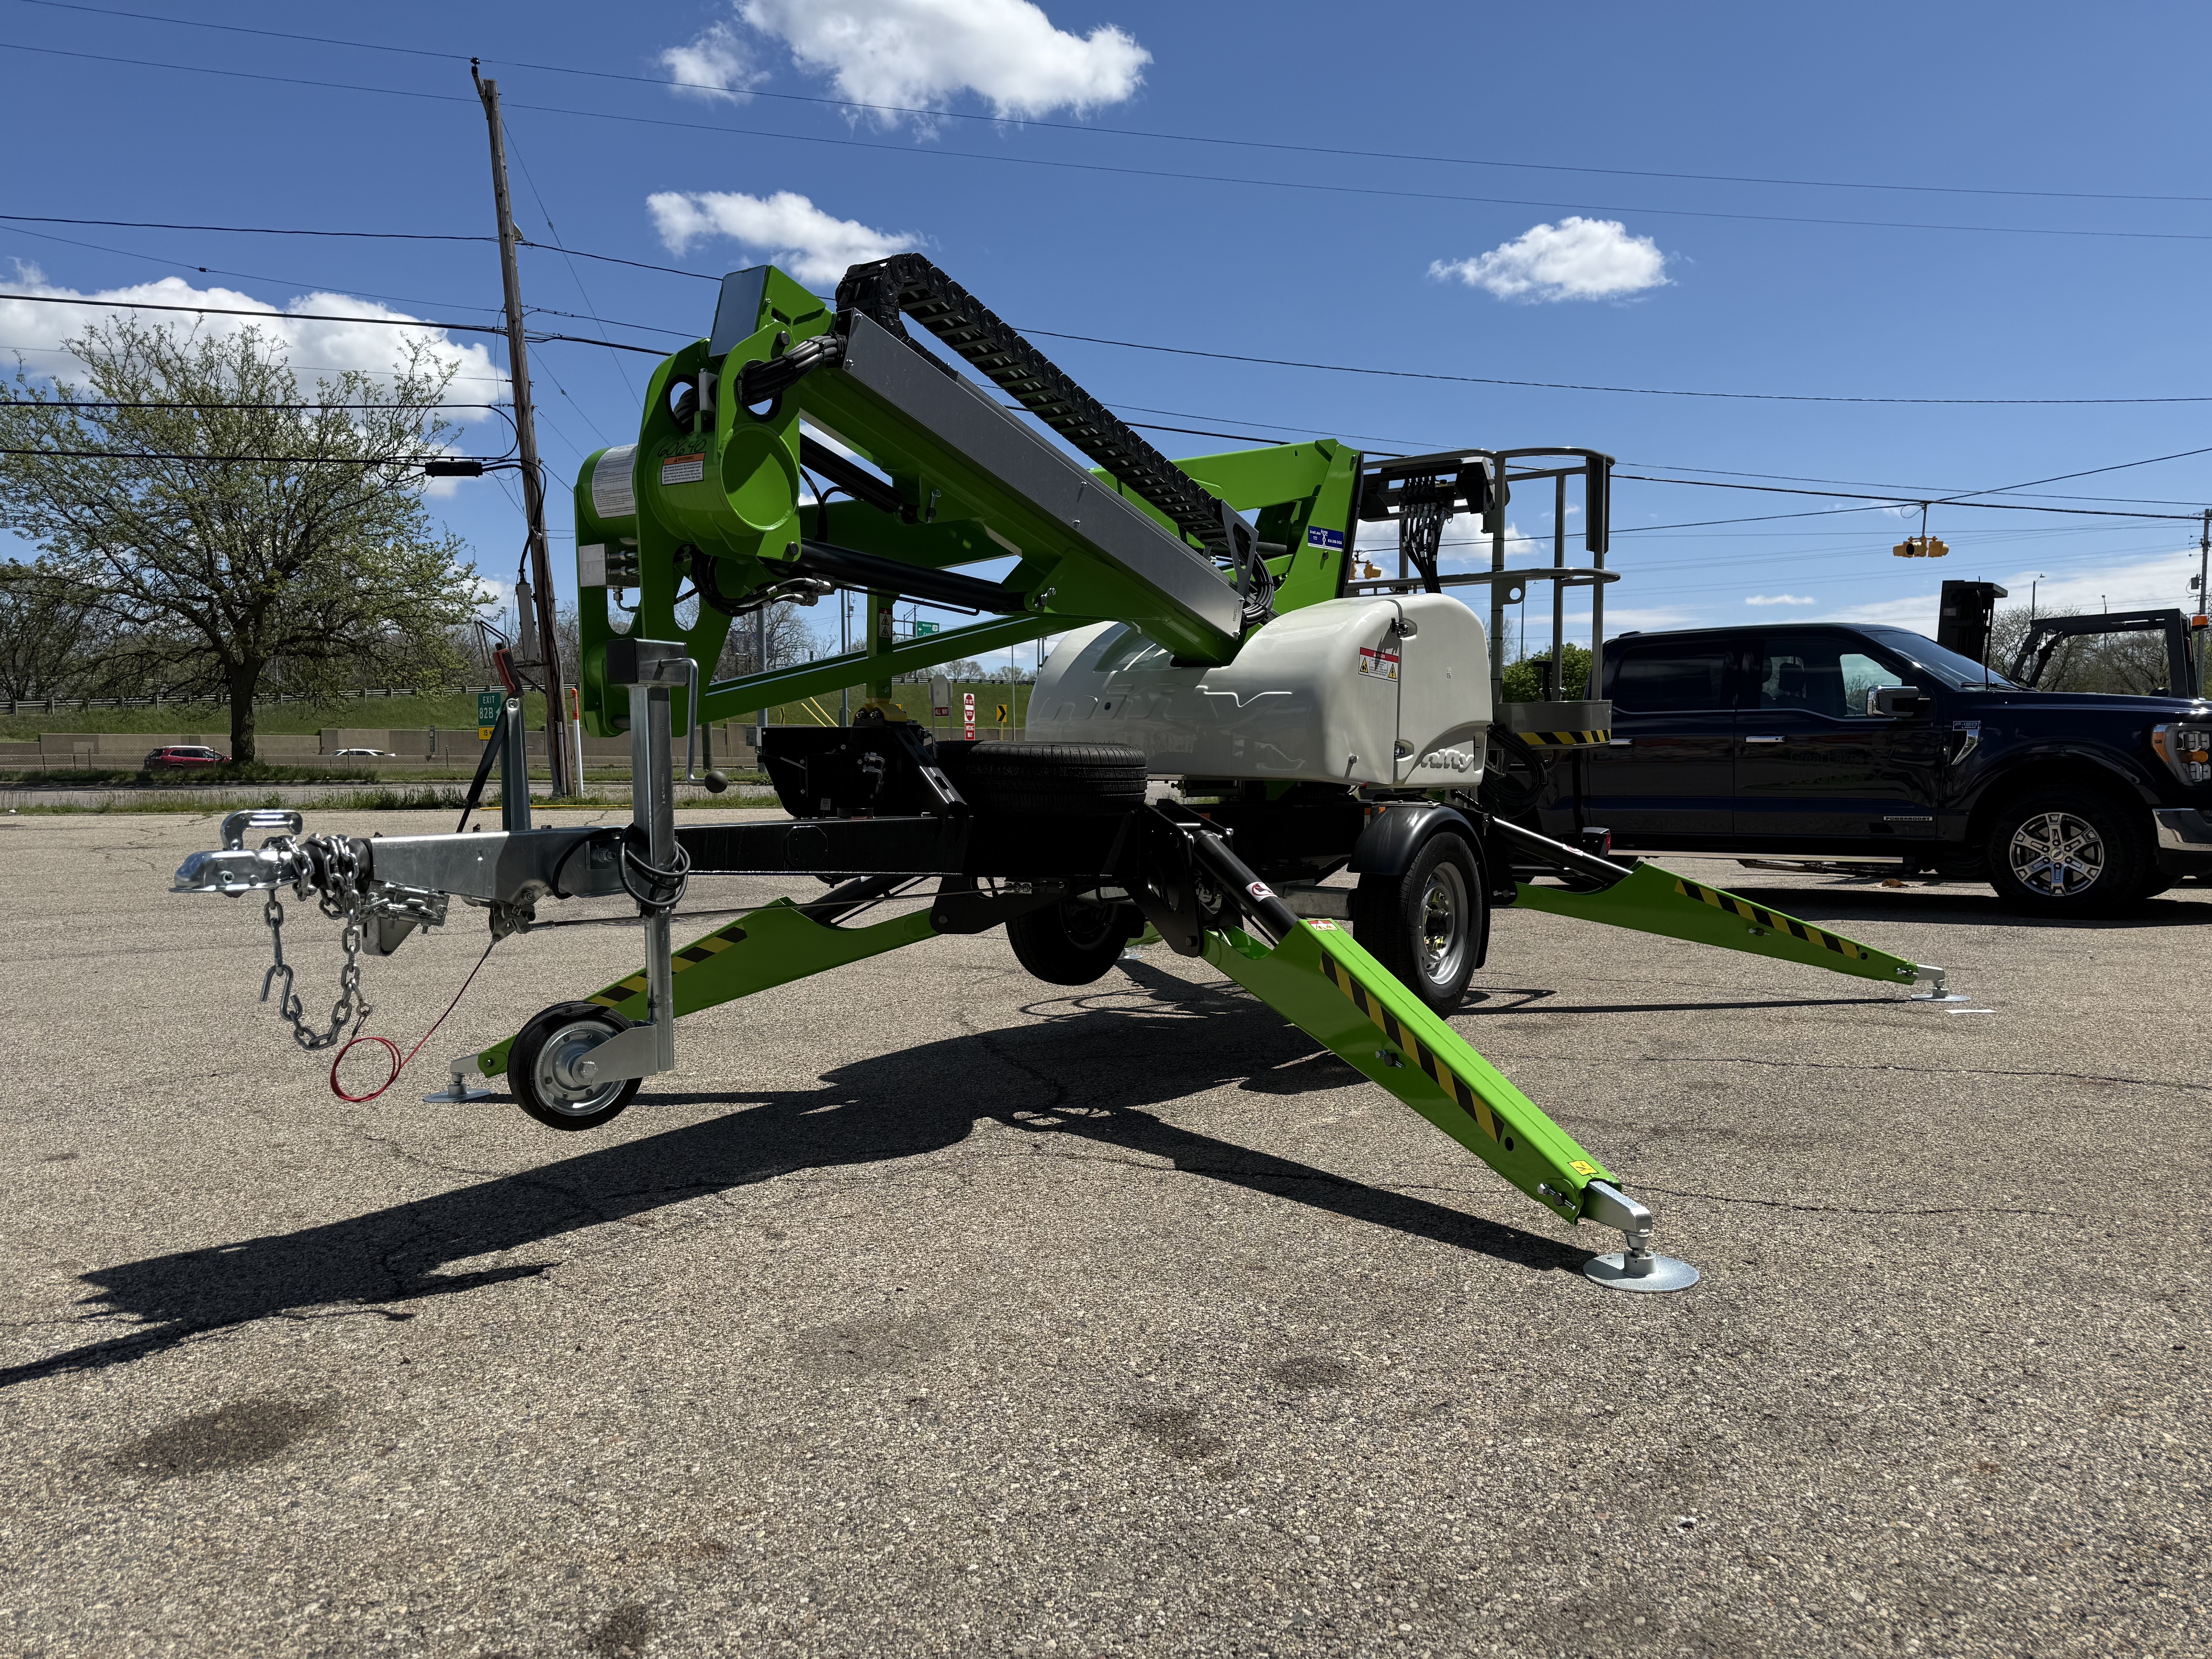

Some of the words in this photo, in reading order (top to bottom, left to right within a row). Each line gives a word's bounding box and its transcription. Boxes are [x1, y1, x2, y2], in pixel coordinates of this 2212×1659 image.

[657, 439, 707, 457] 60640
[483, 696, 495, 704] EXIT
[479, 707, 493, 719] 82B
[1421, 749, 1474, 773] nifty
[1790, 750, 1825, 763] Great
[1828, 750, 1865, 764] Lakes
